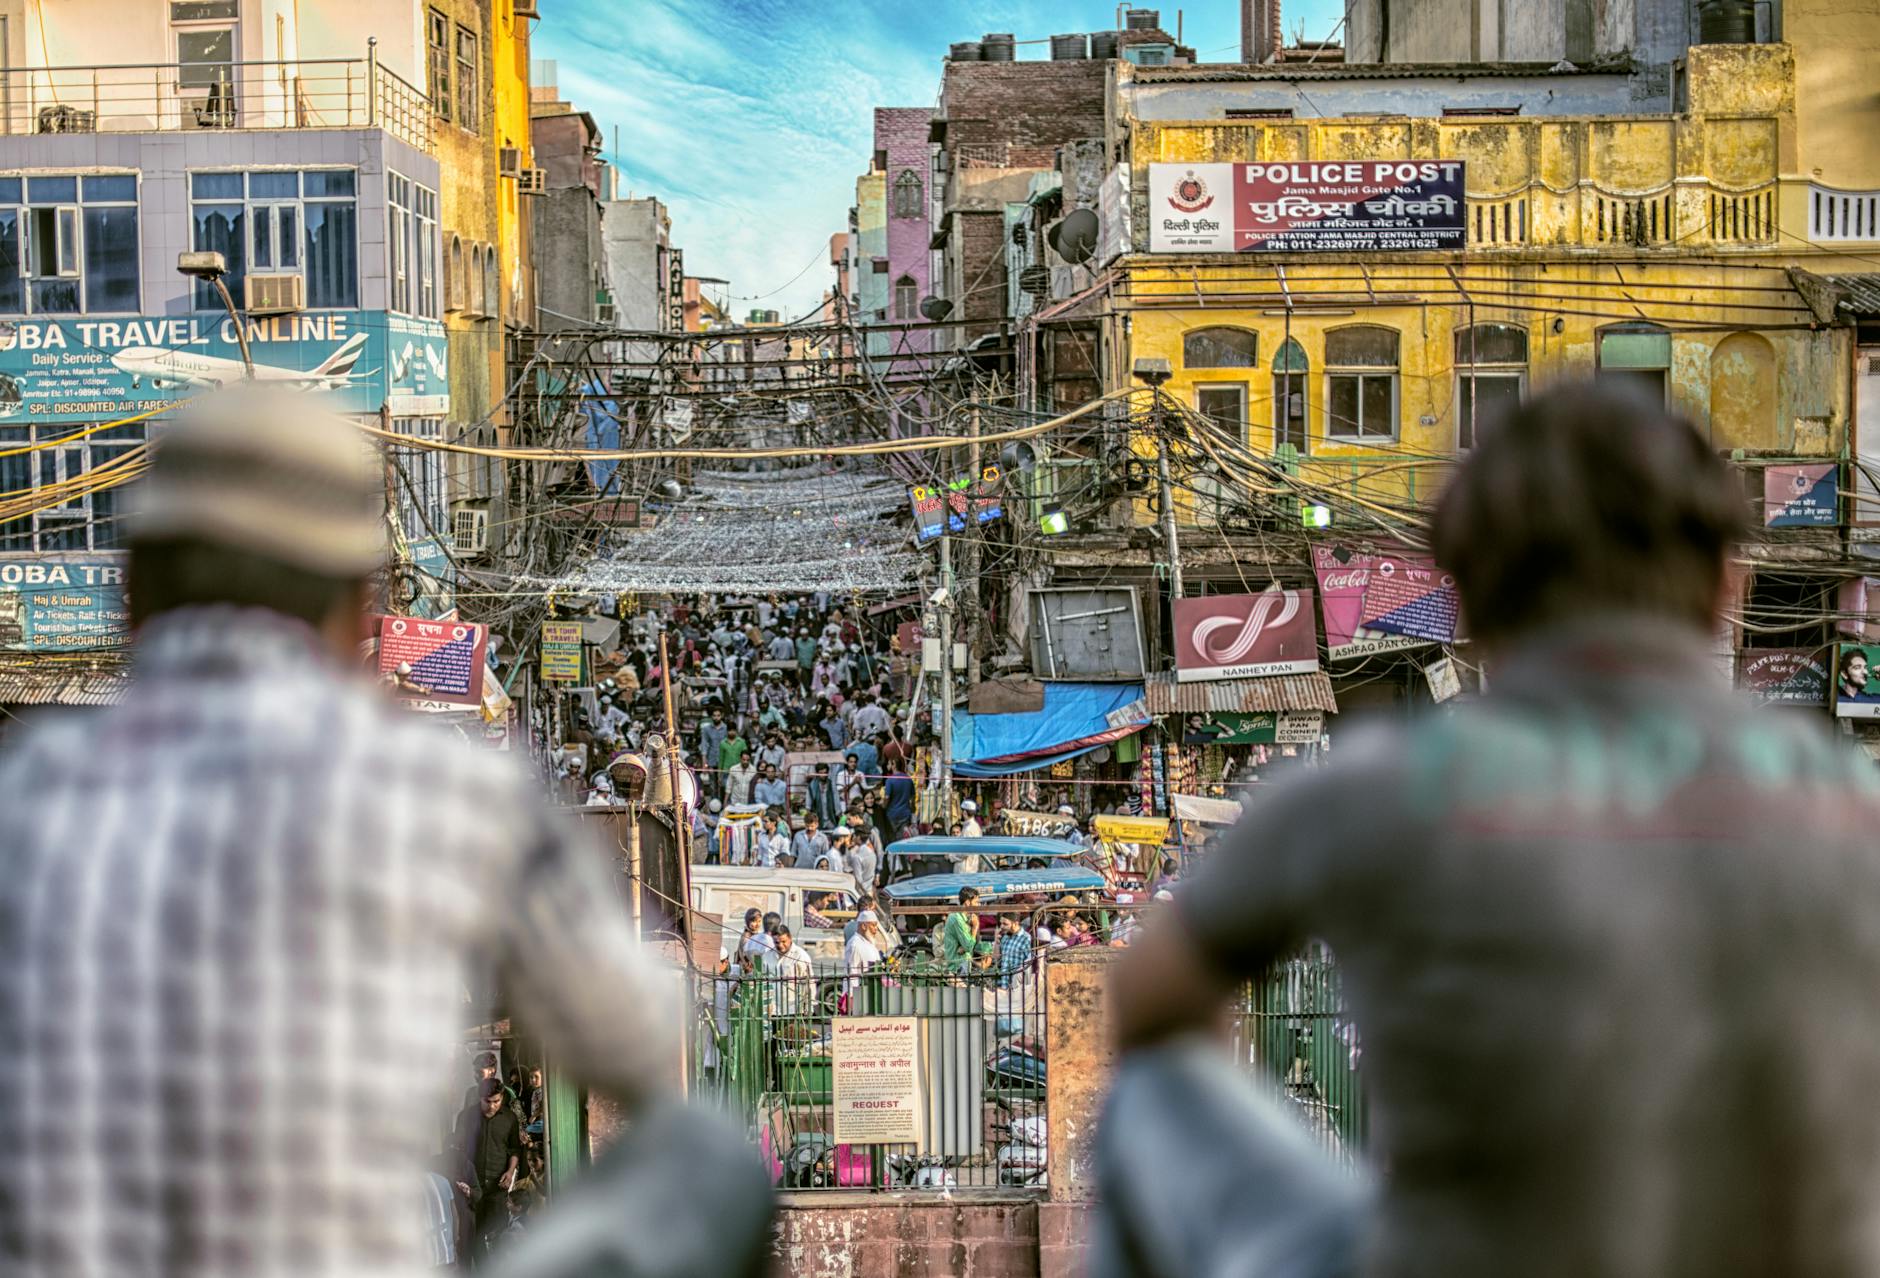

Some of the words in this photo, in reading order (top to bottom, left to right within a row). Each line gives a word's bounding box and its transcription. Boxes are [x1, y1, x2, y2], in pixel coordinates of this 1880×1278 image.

[1246, 164, 1363, 184] POLICE
[1375, 163, 1461, 182] POST
[1319, 186, 1358, 196] Masjid
[1362, 185, 1391, 194] Gate
[1394, 185, 1422, 193] No.1
[1248, 195, 1357, 224] पुलिस
[1364, 193, 1458, 216] चौकी
[1163, 219, 1190, 231] दिल्ली
[1192, 218, 1219, 234] पुलिस
[1287, 220, 1320, 228] जामा
[1372, 217, 1394, 227] गेट
[1267, 240, 1288, 249] PH:
[1291, 239, 1378, 250] 011-23269777,
[1380, 239, 1438, 248] 23261625
[76, 319, 210, 348] TRAVEL
[220, 315, 347, 344] ONLINE
[32, 352, 60, 366] Daily
[62, 353, 103, 364] Service
[29, 403, 52, 415] SPL:
[54, 400, 116, 414] DISCOUNTED
[118, 400, 135, 412] AIR
[1, 564, 71, 585] OBA
[33, 595, 49, 607] Haj
[51, 595, 58, 605] &
[61, 595, 92, 606] Umrah
[33, 611, 45, 619] Air
[47, 611, 76, 620] Tickets,
[98, 611, 130, 620] E-Ticke
[33, 623, 62, 632] Tourist
[78, 623, 106, 632] Tickets
[417, 623, 443, 636] सूचना
[56, 635, 114, 646] DISCOUNTED
[1335, 643, 1376, 658] ASHFAQ
[1377, 640, 1399, 651] PAN
[1223, 666, 1268, 677] NANHEY
[1271, 664, 1293, 674] PAN
[1241, 718, 1272, 732] Sprite
[1006, 881, 1065, 892] Saksham
[890, 1058, 912, 1068] अपील
[852, 1100, 900, 1109] REQUEST
